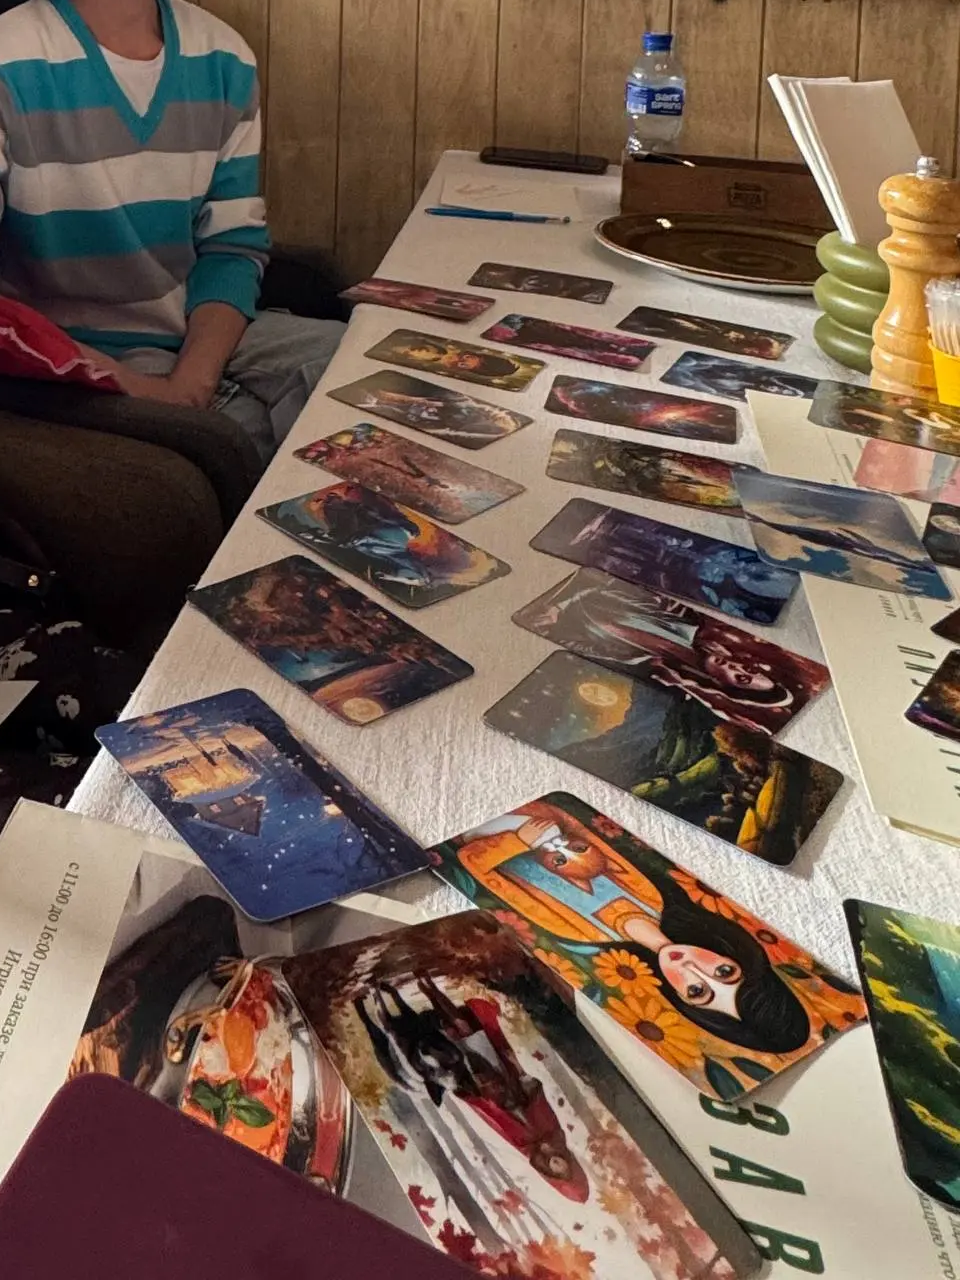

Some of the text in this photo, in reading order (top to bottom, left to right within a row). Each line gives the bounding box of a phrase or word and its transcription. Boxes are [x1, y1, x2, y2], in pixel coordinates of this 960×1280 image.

[55, 872, 79, 905] 11:00
[47, 904, 62, 923] до
[38, 925, 58, 960] 16:00
[20, 959, 40, 992] при
[3, 993, 27, 1045] заказе
